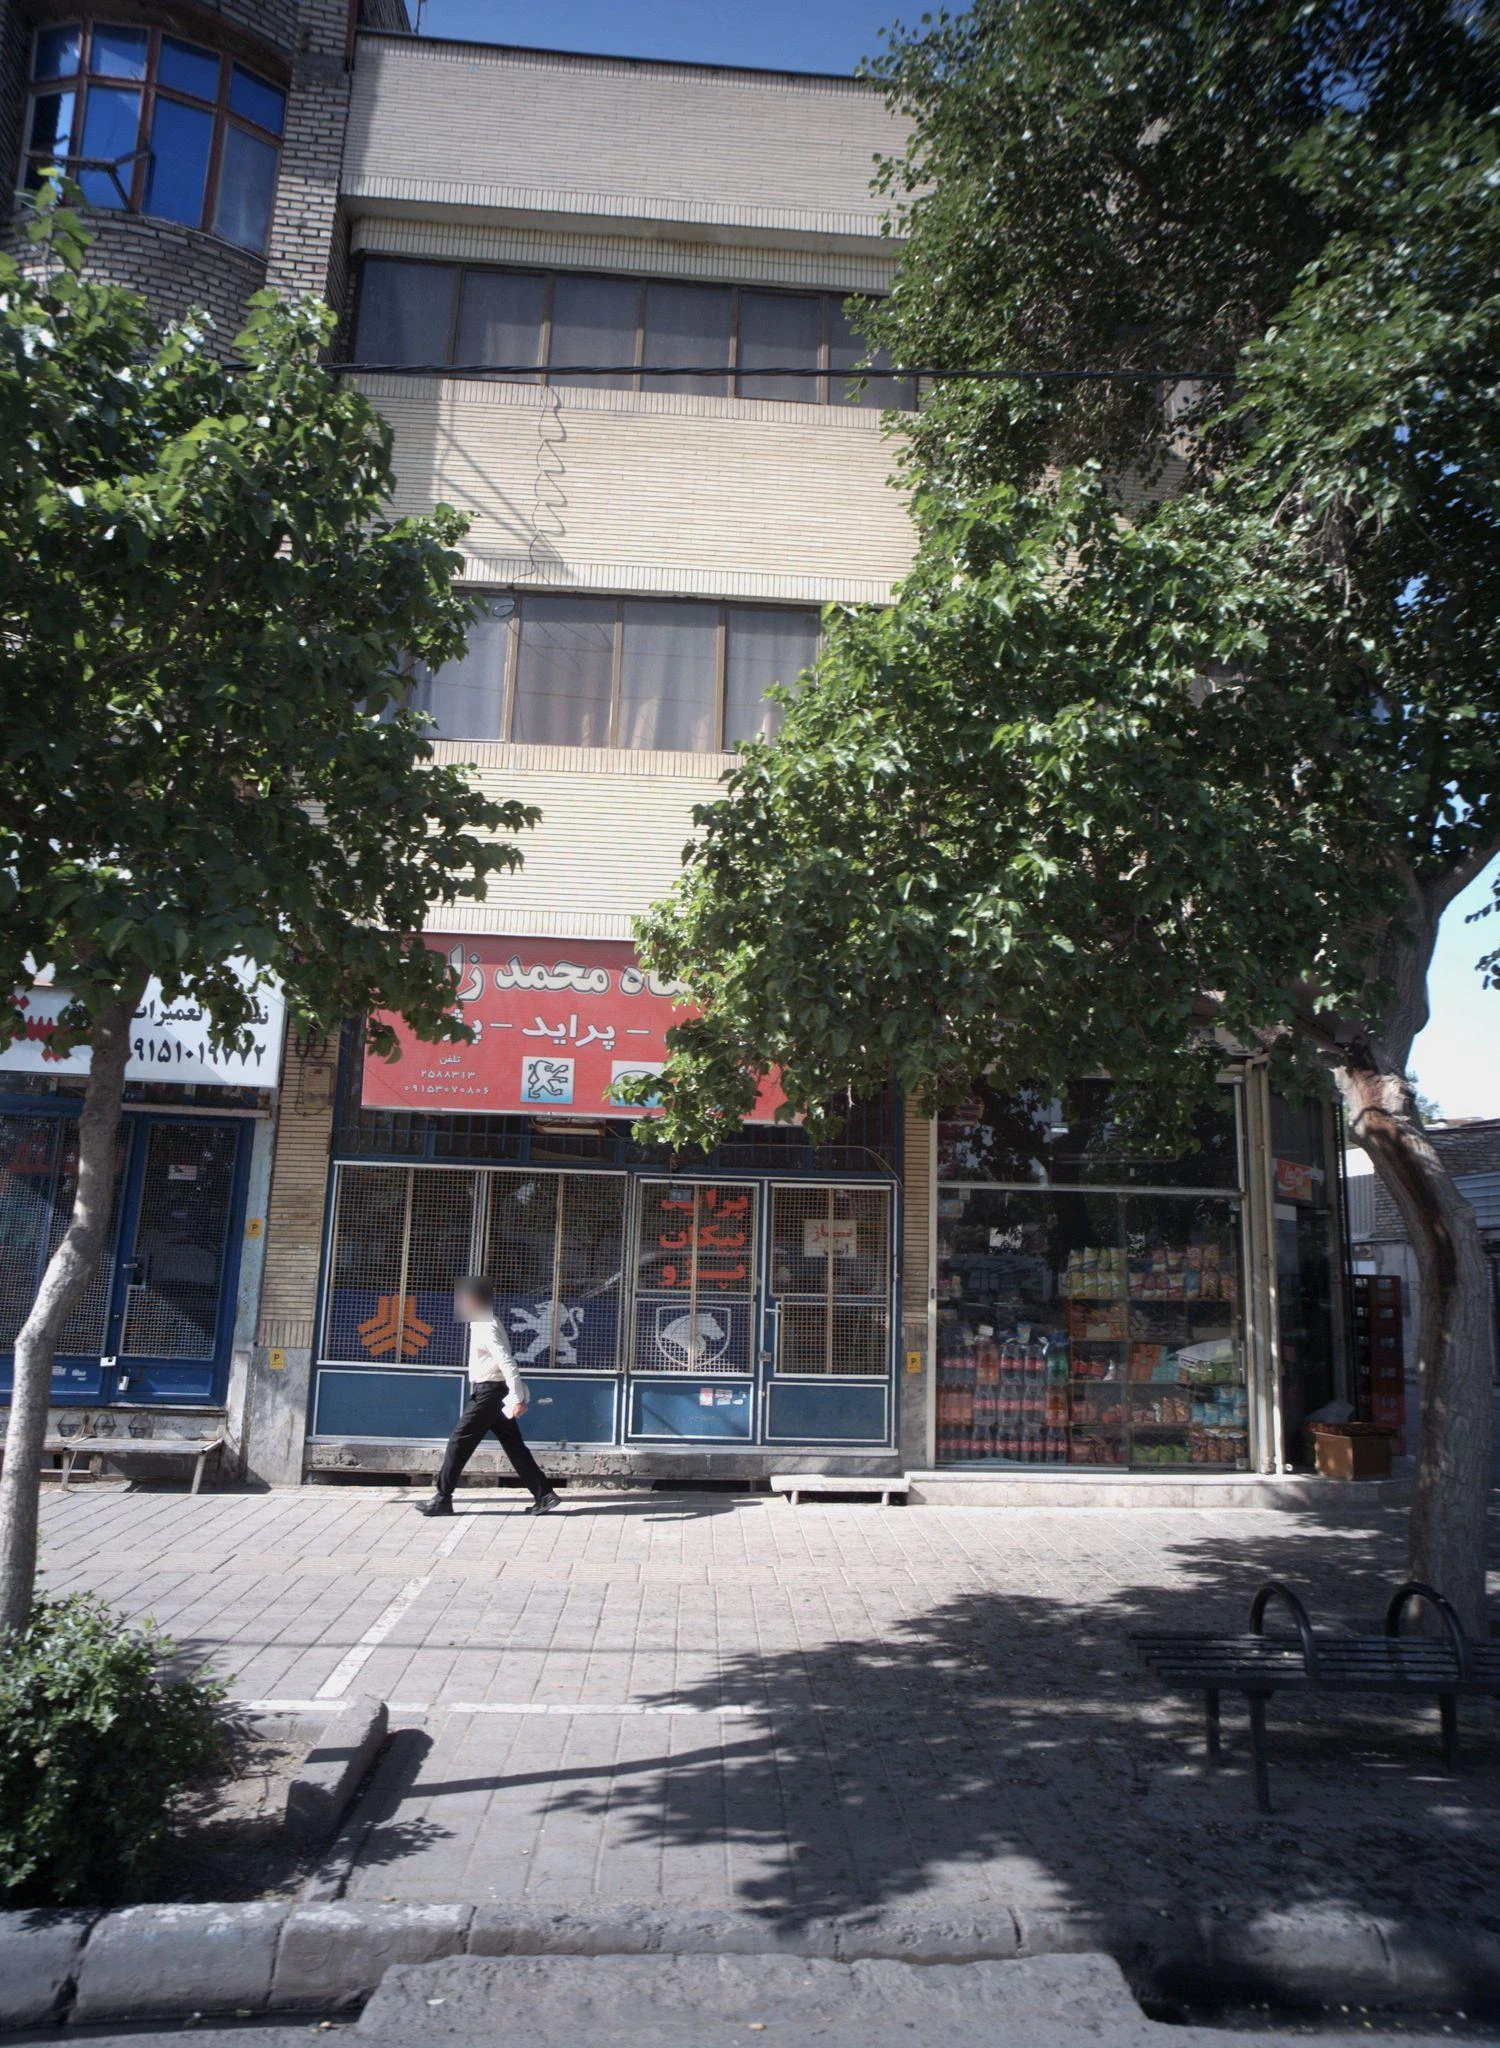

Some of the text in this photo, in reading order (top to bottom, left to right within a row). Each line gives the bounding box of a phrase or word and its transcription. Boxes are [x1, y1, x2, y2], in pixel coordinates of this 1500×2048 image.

[496, 955, 609, 993] محمد
[521, 1014, 616, 1050] پراید
[440, 1054, 461, 1064] تلفن
[660, 1224, 745, 1258] پیکان
[658, 1256, 745, 1290] پژو
